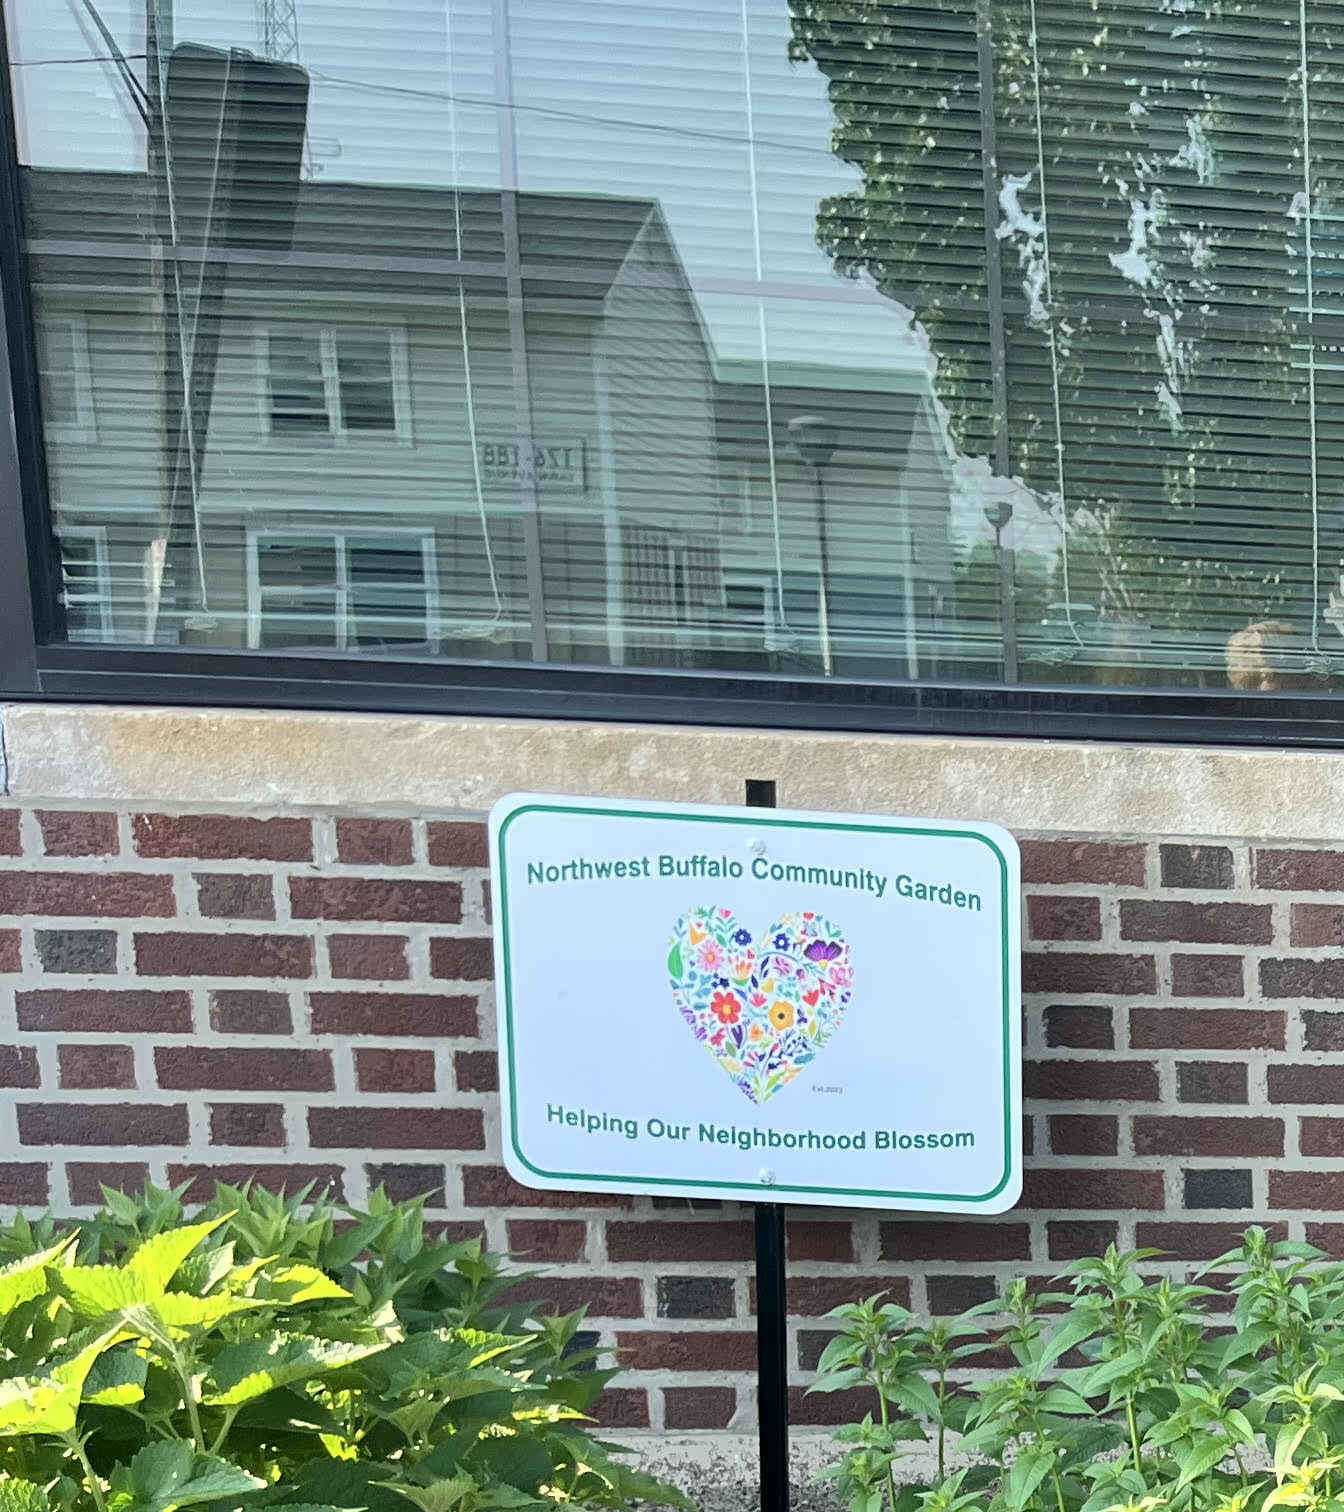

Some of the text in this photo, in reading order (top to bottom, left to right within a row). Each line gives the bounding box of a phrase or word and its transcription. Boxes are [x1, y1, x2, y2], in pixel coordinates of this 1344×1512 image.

[527, 855, 982, 911] Northwest Buffalo Community Garden
[547, 1103, 975, 1150] Helping Our Neighborhood Blossom
